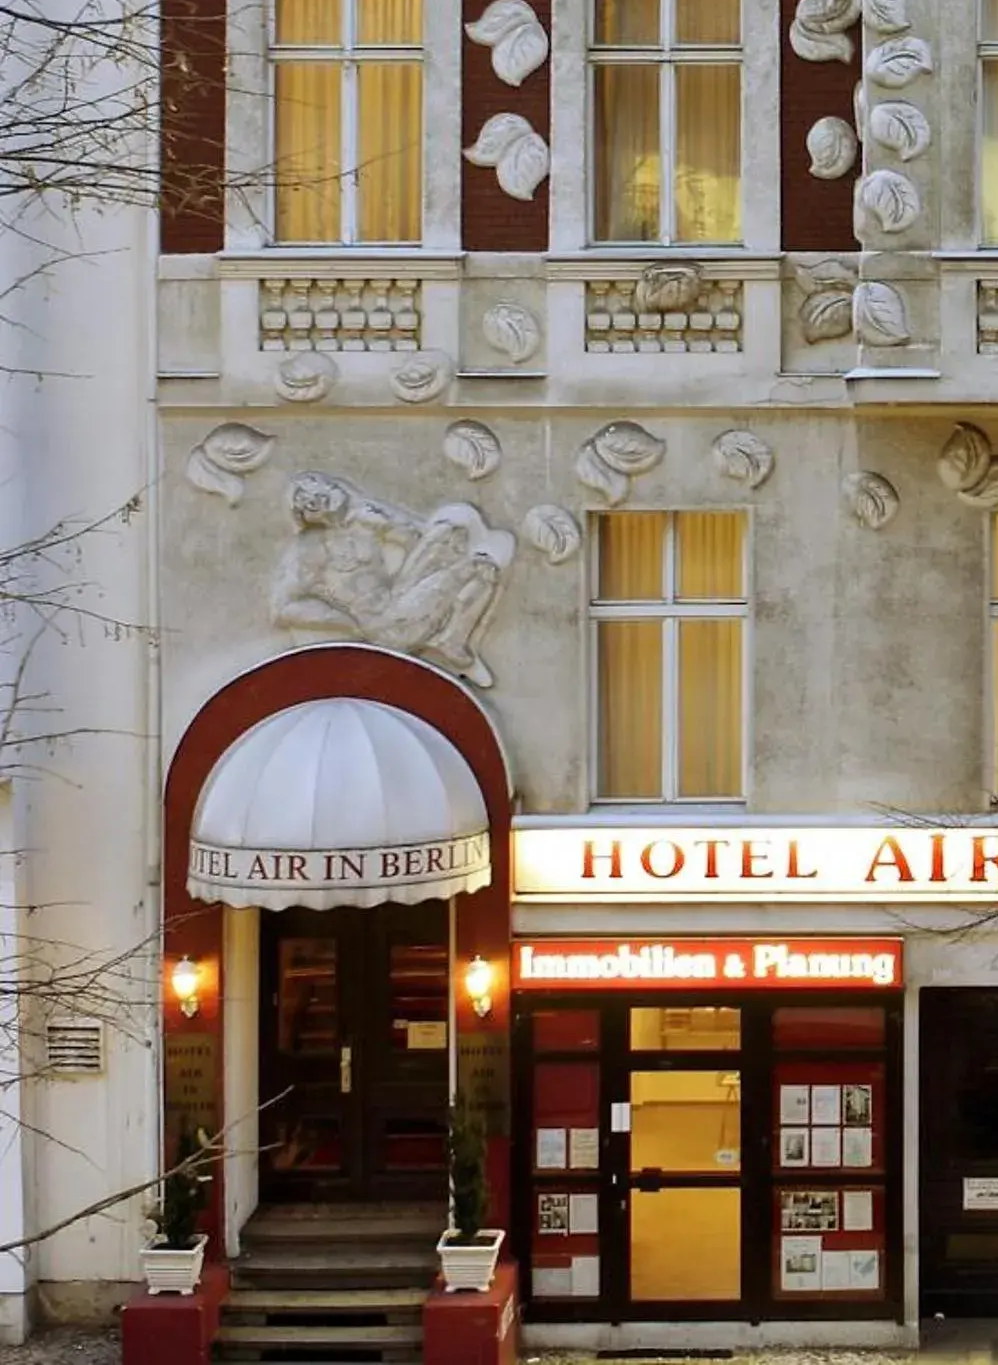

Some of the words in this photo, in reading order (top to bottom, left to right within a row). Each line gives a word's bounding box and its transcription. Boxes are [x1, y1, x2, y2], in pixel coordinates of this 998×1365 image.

[247, 853, 310, 881] AIR
[323, 853, 368, 881] IN
[379, 836, 484, 879] BERLIN
[581, 839, 819, 879] HOTEL
[520, 945, 717, 979] Immobilien
[723, 953, 747, 978] &
[753, 944, 896, 986] Planung
